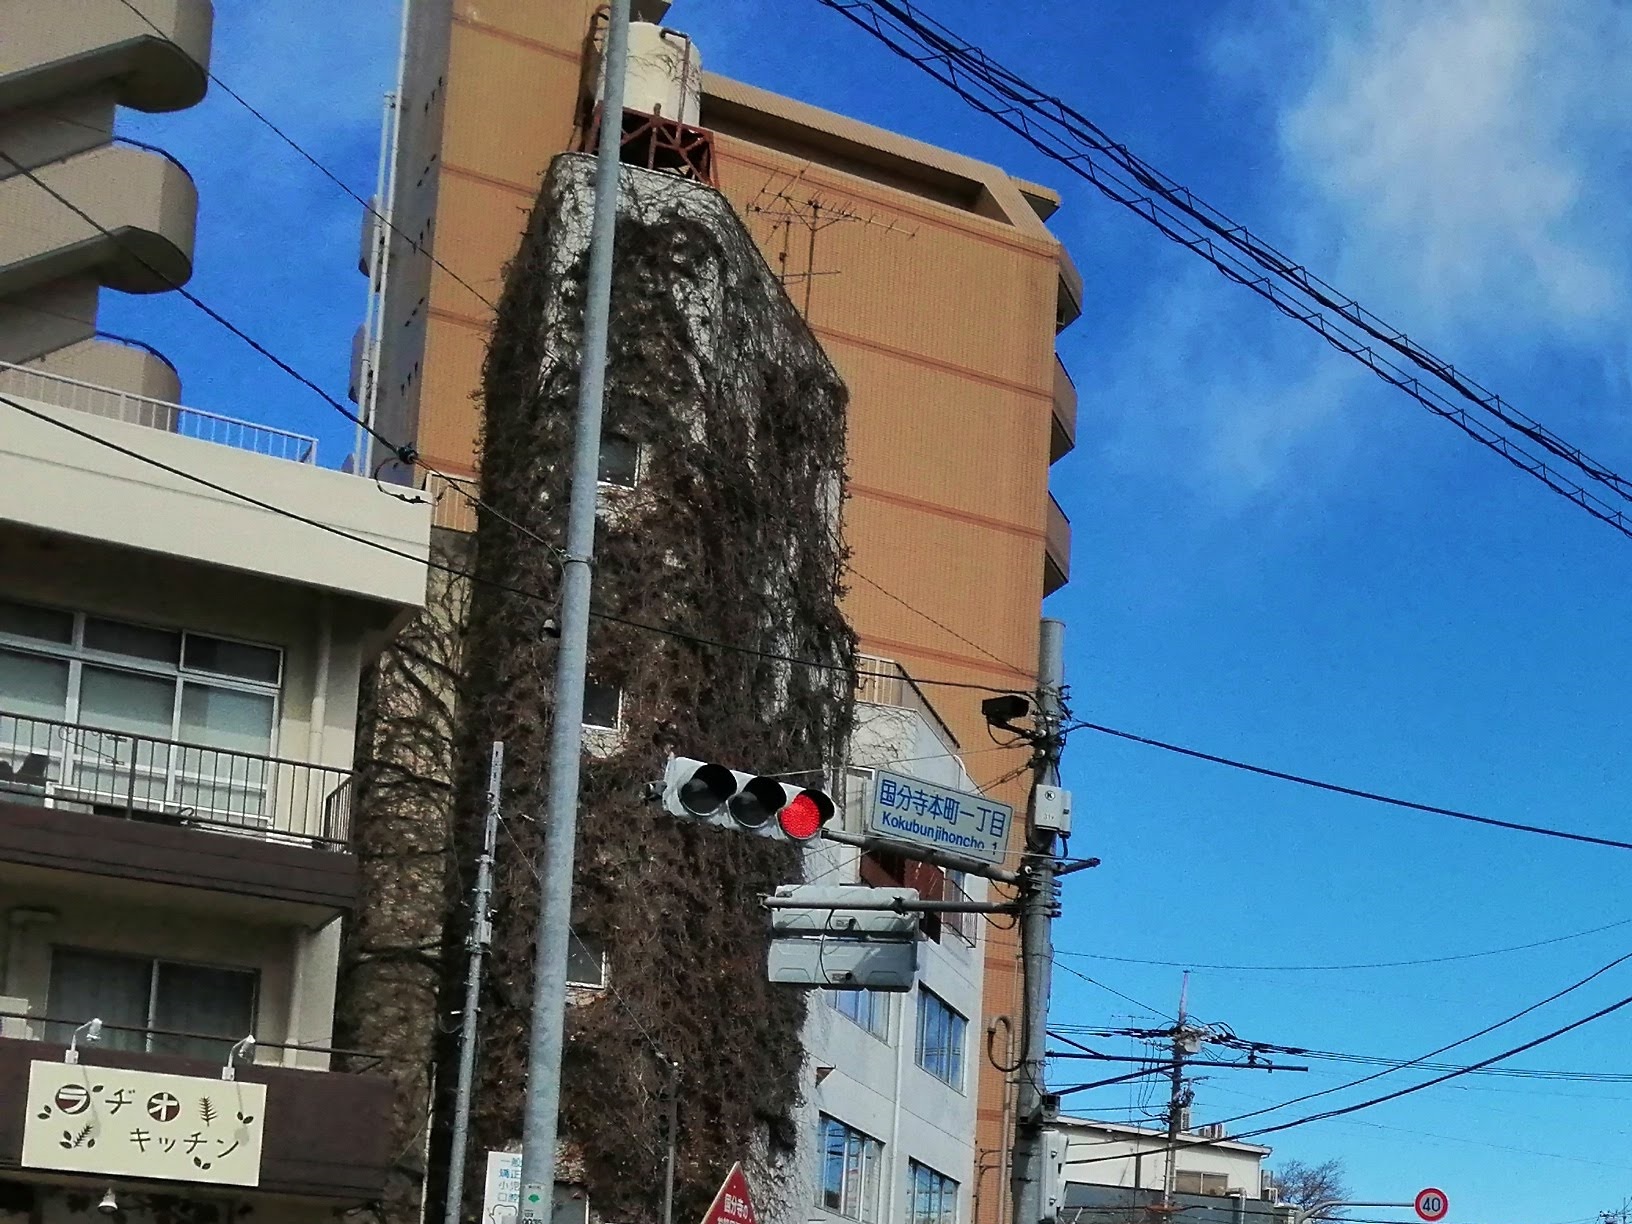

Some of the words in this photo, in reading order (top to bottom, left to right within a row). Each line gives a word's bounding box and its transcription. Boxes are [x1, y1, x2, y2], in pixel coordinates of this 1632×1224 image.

[880, 779, 1006, 838] 国分寺本町一丁目
[882, 811, 985, 852] Kokubunjihoncho
[992, 841, 998, 855] 1
[55, 1084, 180, 1122] ラヂオ
[130, 1128, 239, 1158] キッチン
[724, 1194, 749, 1220] 国分寺の
[1422, 1197, 1442, 1212] 40
